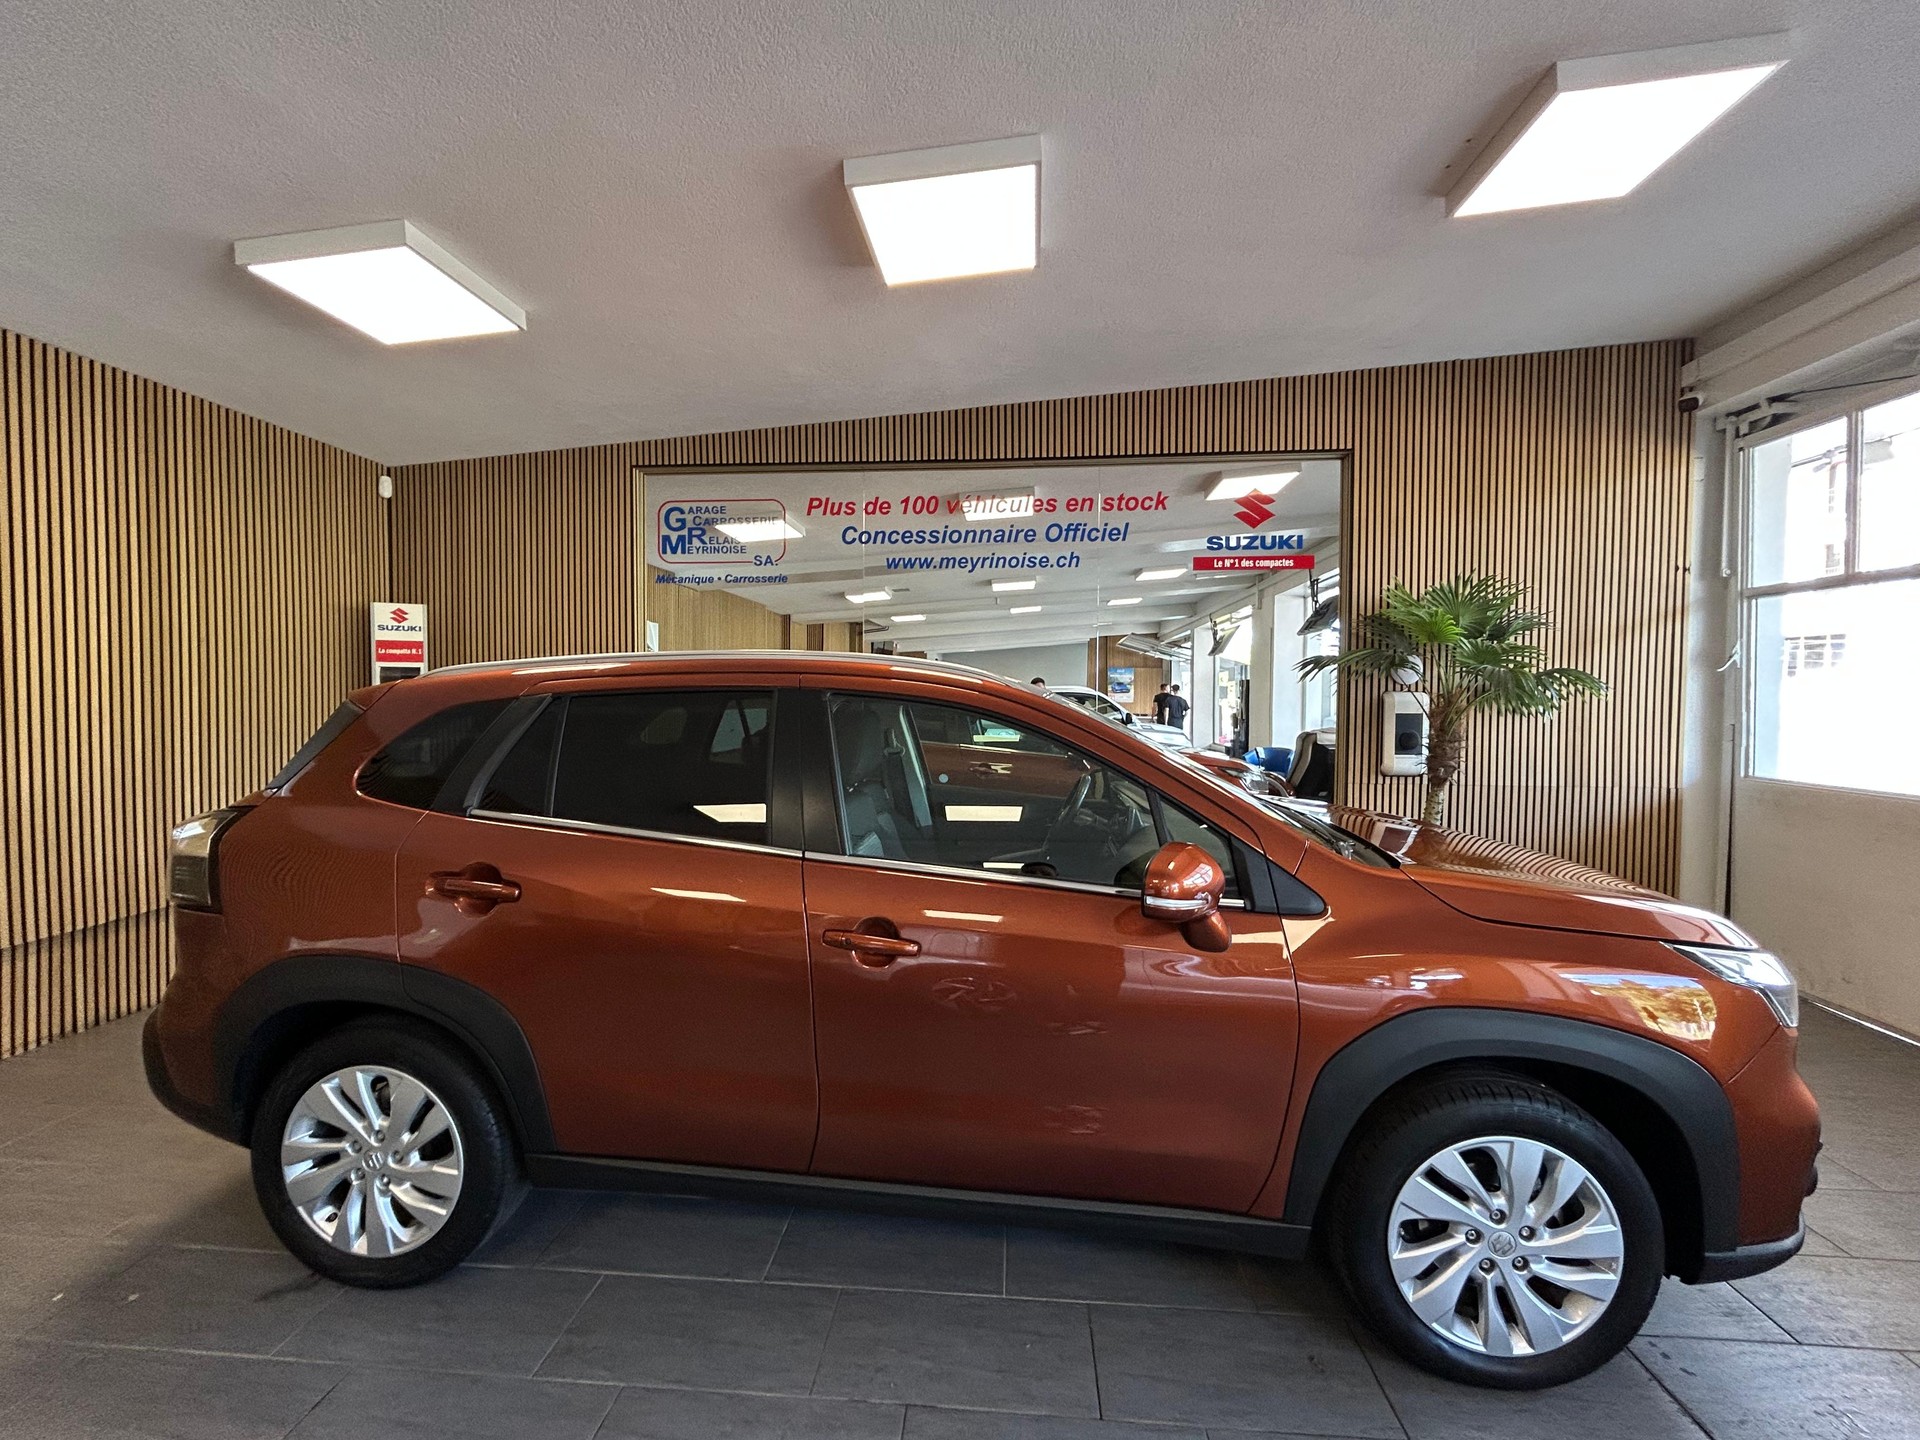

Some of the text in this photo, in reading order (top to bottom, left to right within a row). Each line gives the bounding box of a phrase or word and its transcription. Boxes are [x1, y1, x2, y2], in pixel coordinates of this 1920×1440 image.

[806, 491, 1170, 516] Plus de 100 véhicules en stock
[664, 506, 727, 532] GARAGE
[842, 522, 1130, 545] Concessionnaire Officiel
[1206, 534, 1304, 551] SUZUKI
[661, 534, 747, 555] MEYRINOISE
[886, 552, 1080, 574] www.meyrinoise.ch
[1213, 558, 1223, 568] Le
[1241, 558, 1254, 568] des
[1255, 558, 1294, 569] compactes
[655, 573, 788, 586] Mécanique Carrosserie
[377, 624, 422, 632] SUZUKI
